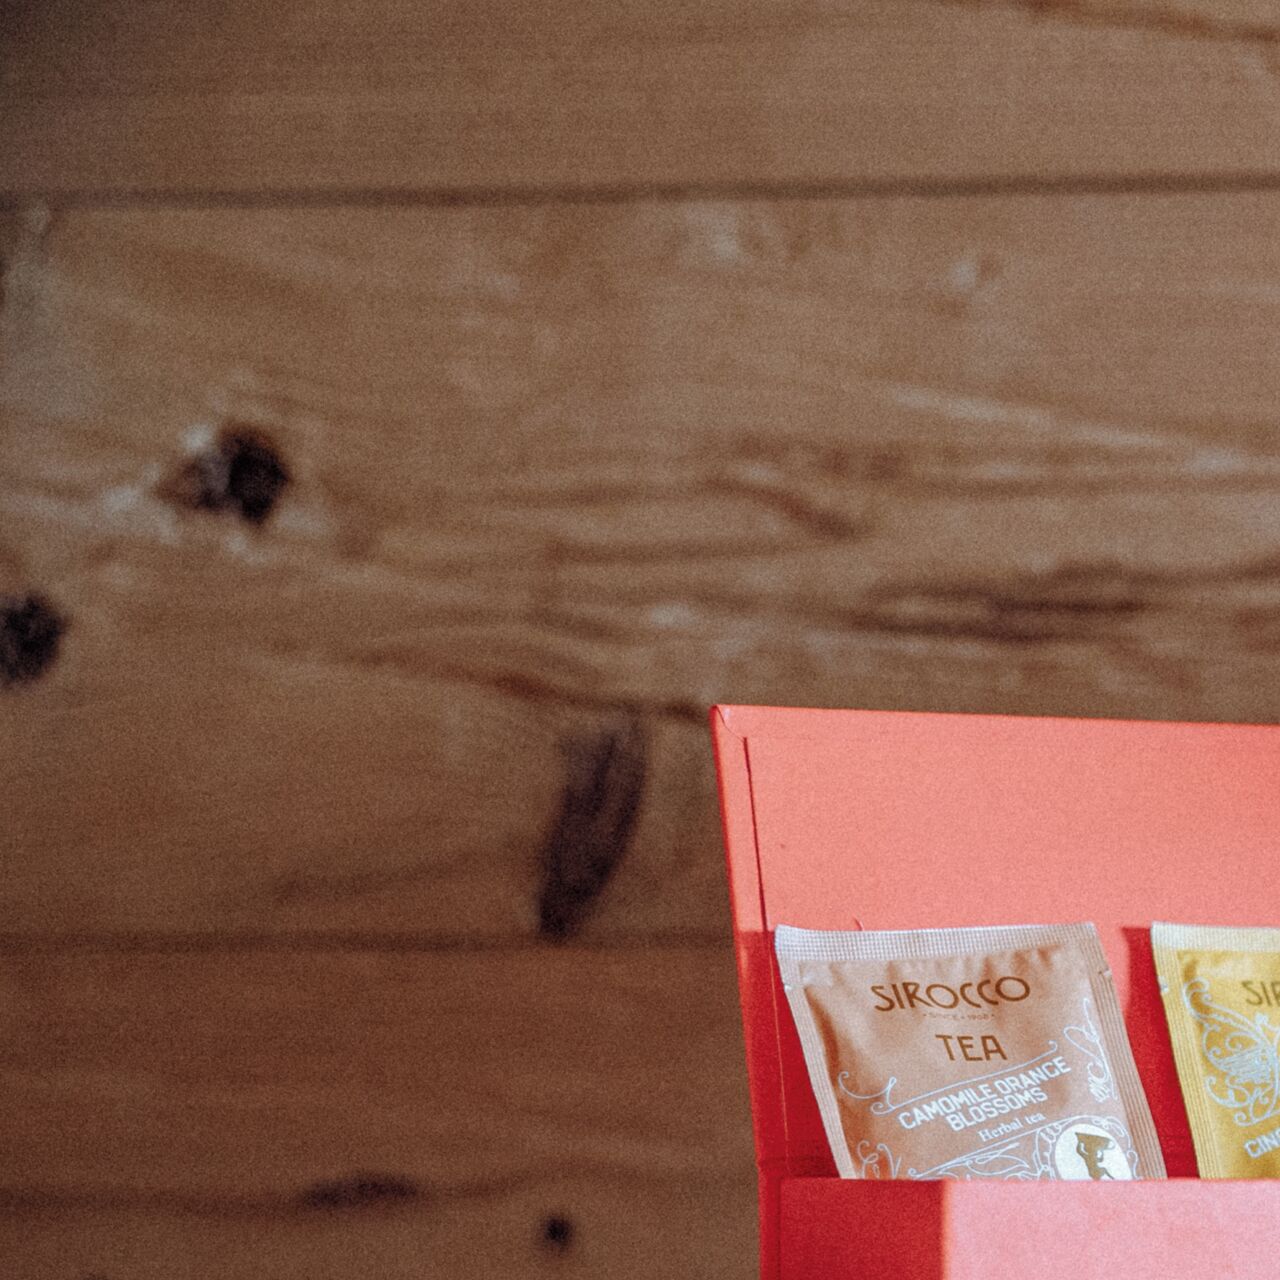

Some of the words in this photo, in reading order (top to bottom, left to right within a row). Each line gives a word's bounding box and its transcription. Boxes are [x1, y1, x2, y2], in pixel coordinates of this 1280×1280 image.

[871, 976, 1031, 1012] SIROCCO
[935, 1034, 1008, 1062] TEA
[898, 1084, 996, 1130] CAMOMILE
[994, 1056, 1071, 1092] ORANGE
[947, 1087, 1049, 1132] BLOSSOMS
[977, 1116, 1023, 1142] Herbal
[1024, 1112, 1046, 1130] tea
